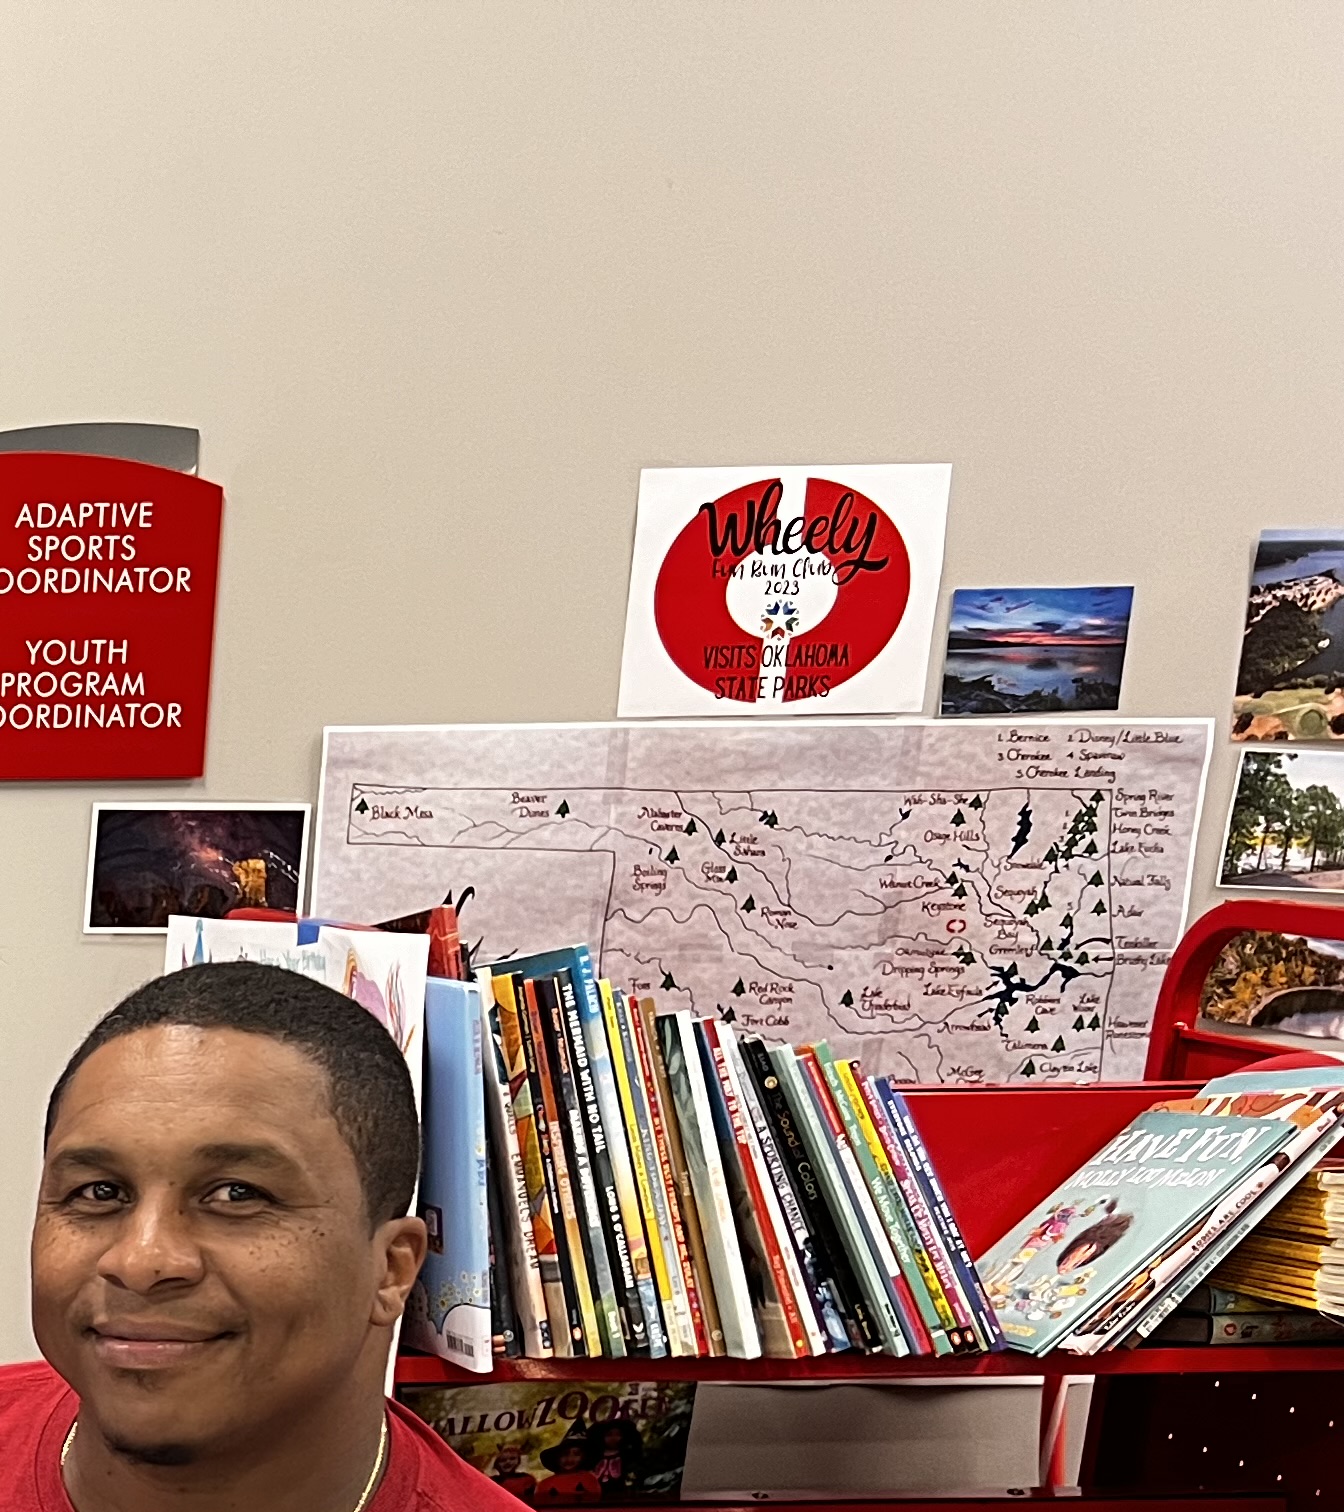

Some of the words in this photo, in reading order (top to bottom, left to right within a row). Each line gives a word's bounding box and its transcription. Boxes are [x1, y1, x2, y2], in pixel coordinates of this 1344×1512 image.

[14, 501, 154, 529] ADAPTIVE
[699, 480, 889, 586] Wheely
[27, 535, 136, 562] SPORTS
[751, 559, 785, 580] Run
[792, 557, 832, 581] Club
[764, 580, 800, 596] 2023
[25, 639, 128, 666] YOUTH
[703, 645, 757, 669] VISITS
[761, 643, 850, 669] OKLAHOMA
[1, 671, 145, 698] PROGRAM
[714, 676, 767, 700] STATE
[772, 675, 832, 699] PARKS
[1006, 730, 1051, 743] Bernice
[511, 792, 547, 804] Beaver
[370, 805, 400, 821] Black
[403, 805, 434, 820] Mesa
[519, 806, 550, 818] Dunes
[924, 830, 951, 845] Osage
[953, 830, 980, 842] Hills
[701, 861, 726, 875] Glass
[761, 906, 791, 918] Roman
[922, 901, 966, 917] Keystone
[997, 929, 1020, 943] Bay
[881, 962, 925, 981] Dripping
[927, 962, 965, 979] Springs
[560, 983, 576, 1008] THE
[583, 978, 600, 1013] PALACIO
[749, 982, 768, 994] Red
[770, 982, 795, 994] Rock
[759, 995, 793, 1011] Canyon
[766, 1014, 790, 1026] Cobb
[566, 1009, 588, 1068] MERMAID
[578, 1068, 595, 1102] WITH
[585, 1103, 599, 1124] NO
[590, 1125, 606, 1153] TAIL
[1089, 1129, 1204, 1167] HAVE
[1184, 1125, 1272, 1166] FUN,
[777, 1110, 800, 1148] Sound
[795, 1160, 819, 1202] Colors
[547, 1120, 568, 1174] INSPIRING
[558, 1177, 576, 1220] OTHERS
[1064, 1166, 1136, 1191] MOLLY
[1125, 1166, 1164, 1185] LOU
[1148, 1167, 1227, 1189] MELON
[760, 1134, 789, 1190] SPORTING
[780, 1192, 804, 1234] CHANCE
[869, 1176, 885, 1195] We
[876, 1193, 895, 1224] Move
[1216, 1207, 1235, 1227] ARE
[1234, 1186, 1257, 1210] COOL
[604, 1185, 618, 1212] LONG
[612, 1222, 634, 1288] O'CALLAGHAN
[885, 1222, 911, 1266] Together
[523, 1230, 539, 1269] DREAM
